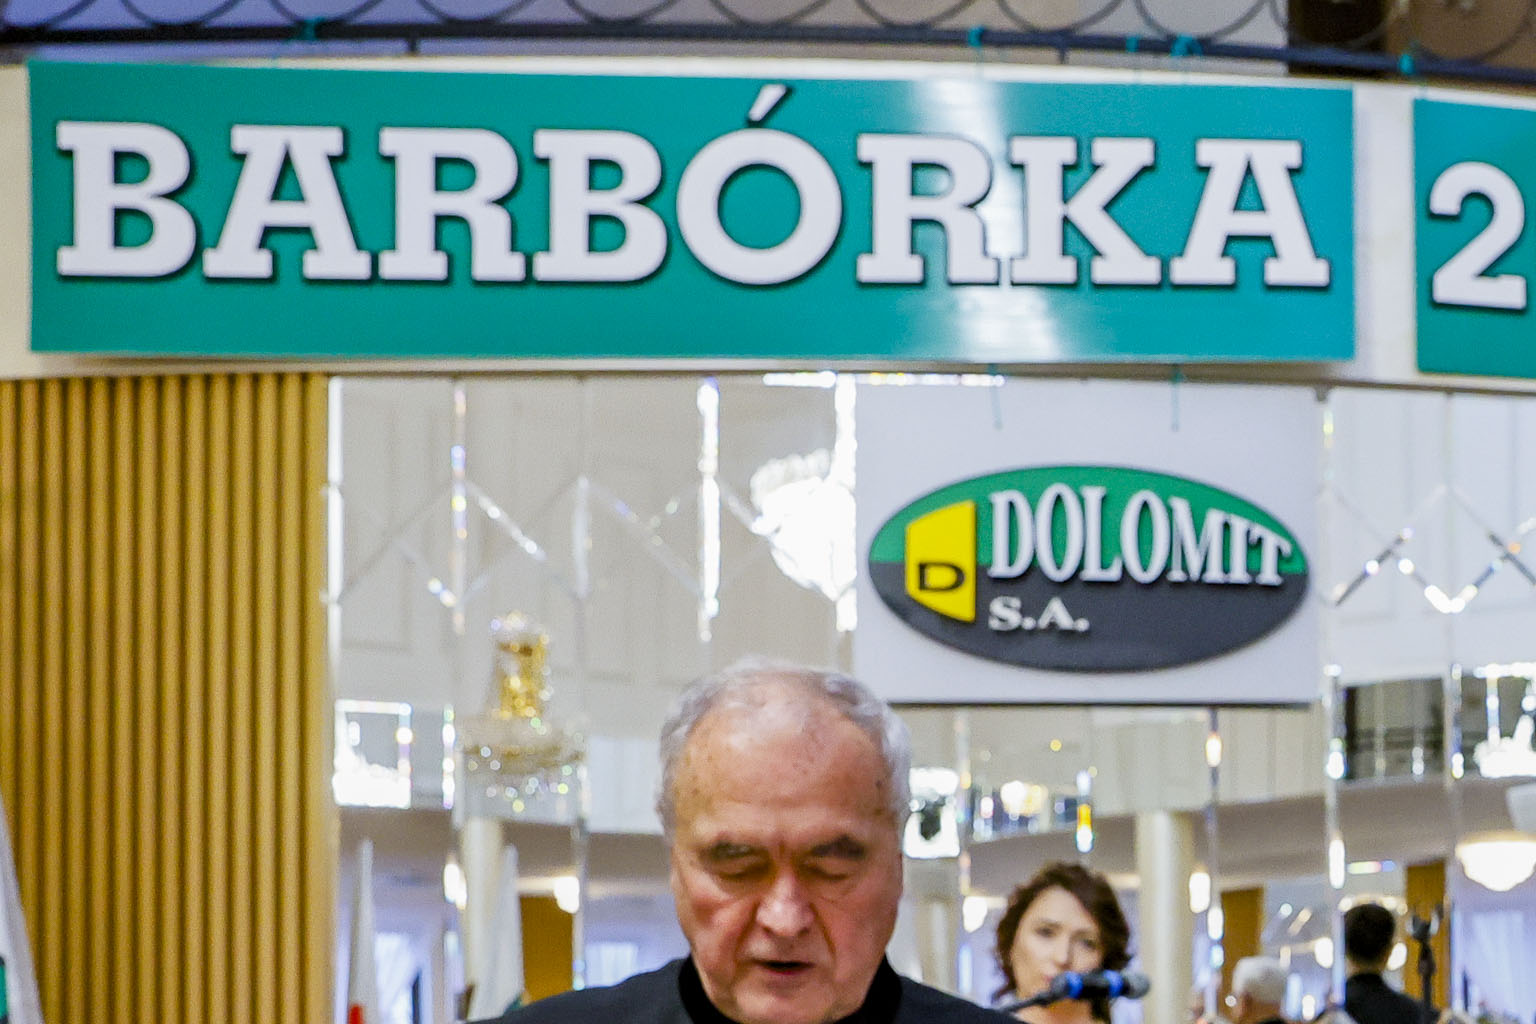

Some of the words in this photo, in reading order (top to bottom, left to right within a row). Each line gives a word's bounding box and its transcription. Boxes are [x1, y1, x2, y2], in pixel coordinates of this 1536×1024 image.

[56, 83, 1331, 287] BARBÓRKA
[987, 482, 1292, 586] DOLOMIT
[987, 596, 1090, 632] S.A.
